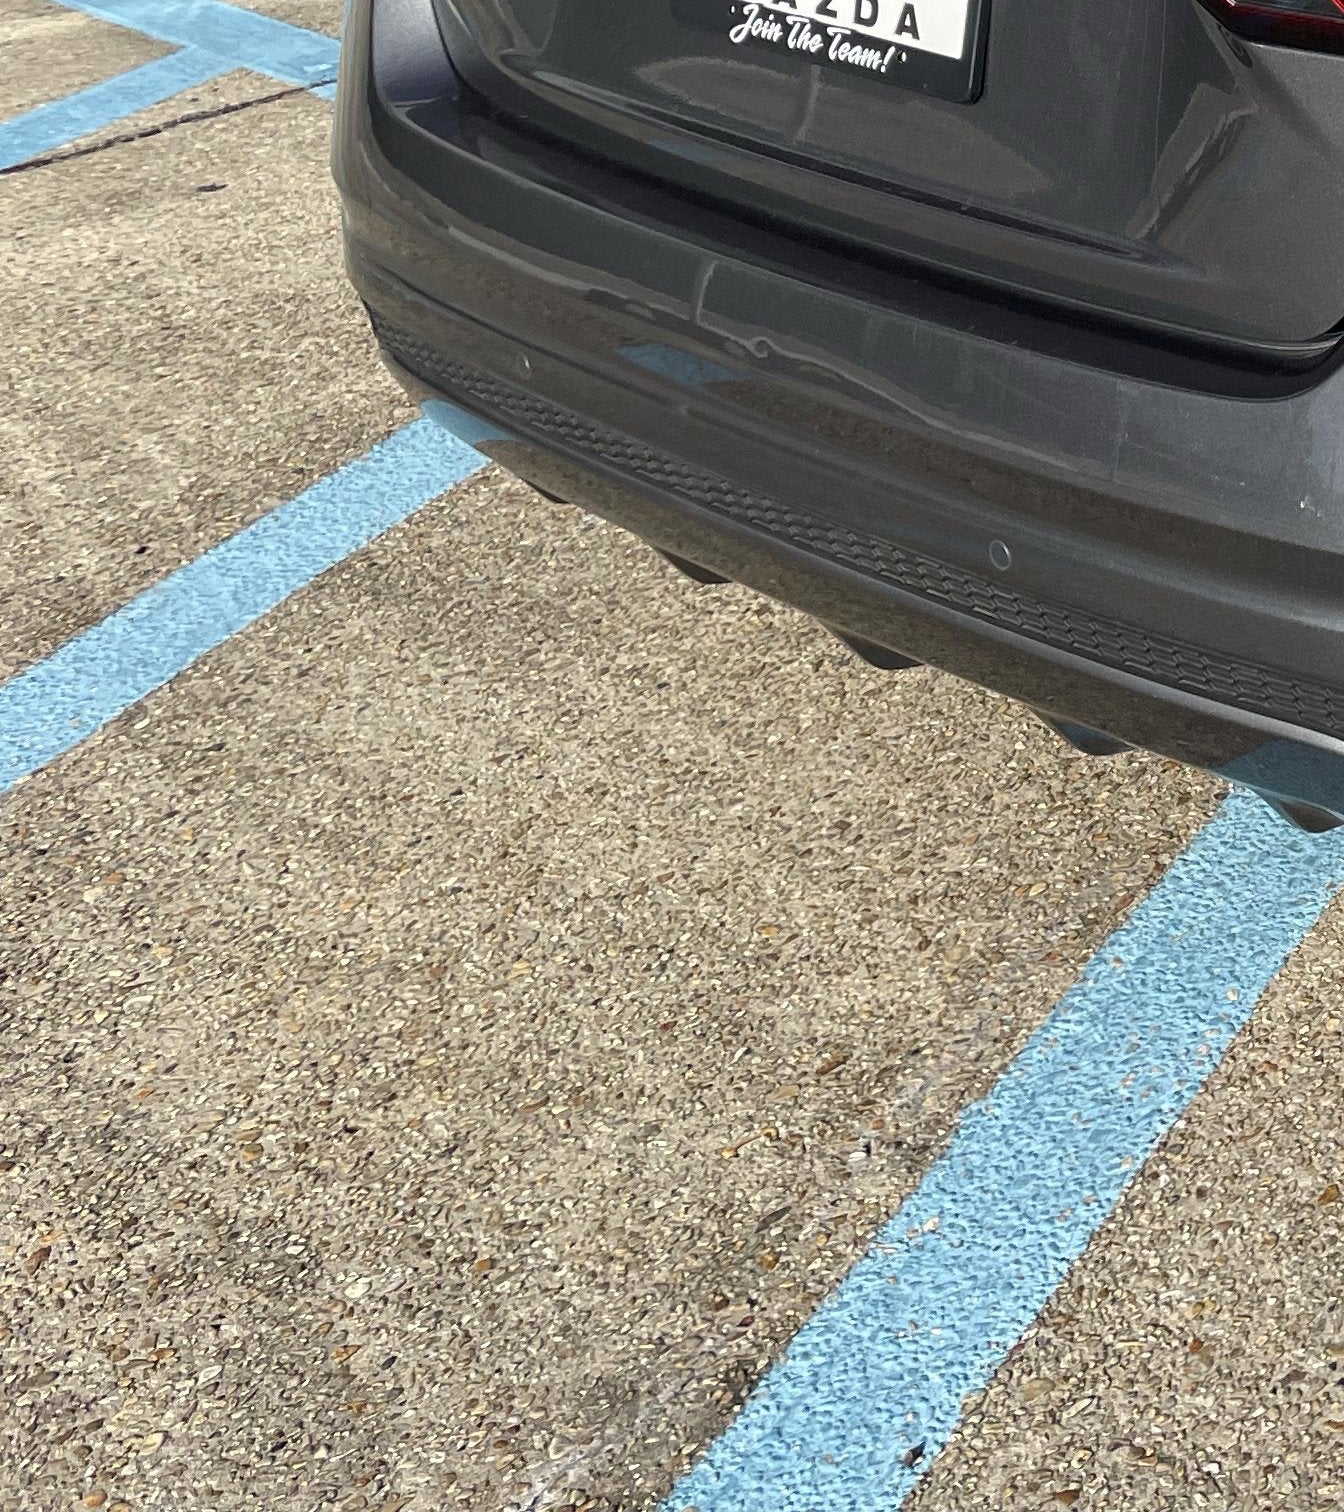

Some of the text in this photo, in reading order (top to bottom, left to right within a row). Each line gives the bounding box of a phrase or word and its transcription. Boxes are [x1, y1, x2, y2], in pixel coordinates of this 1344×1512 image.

[729, 3, 896, 73] Join The Team!
